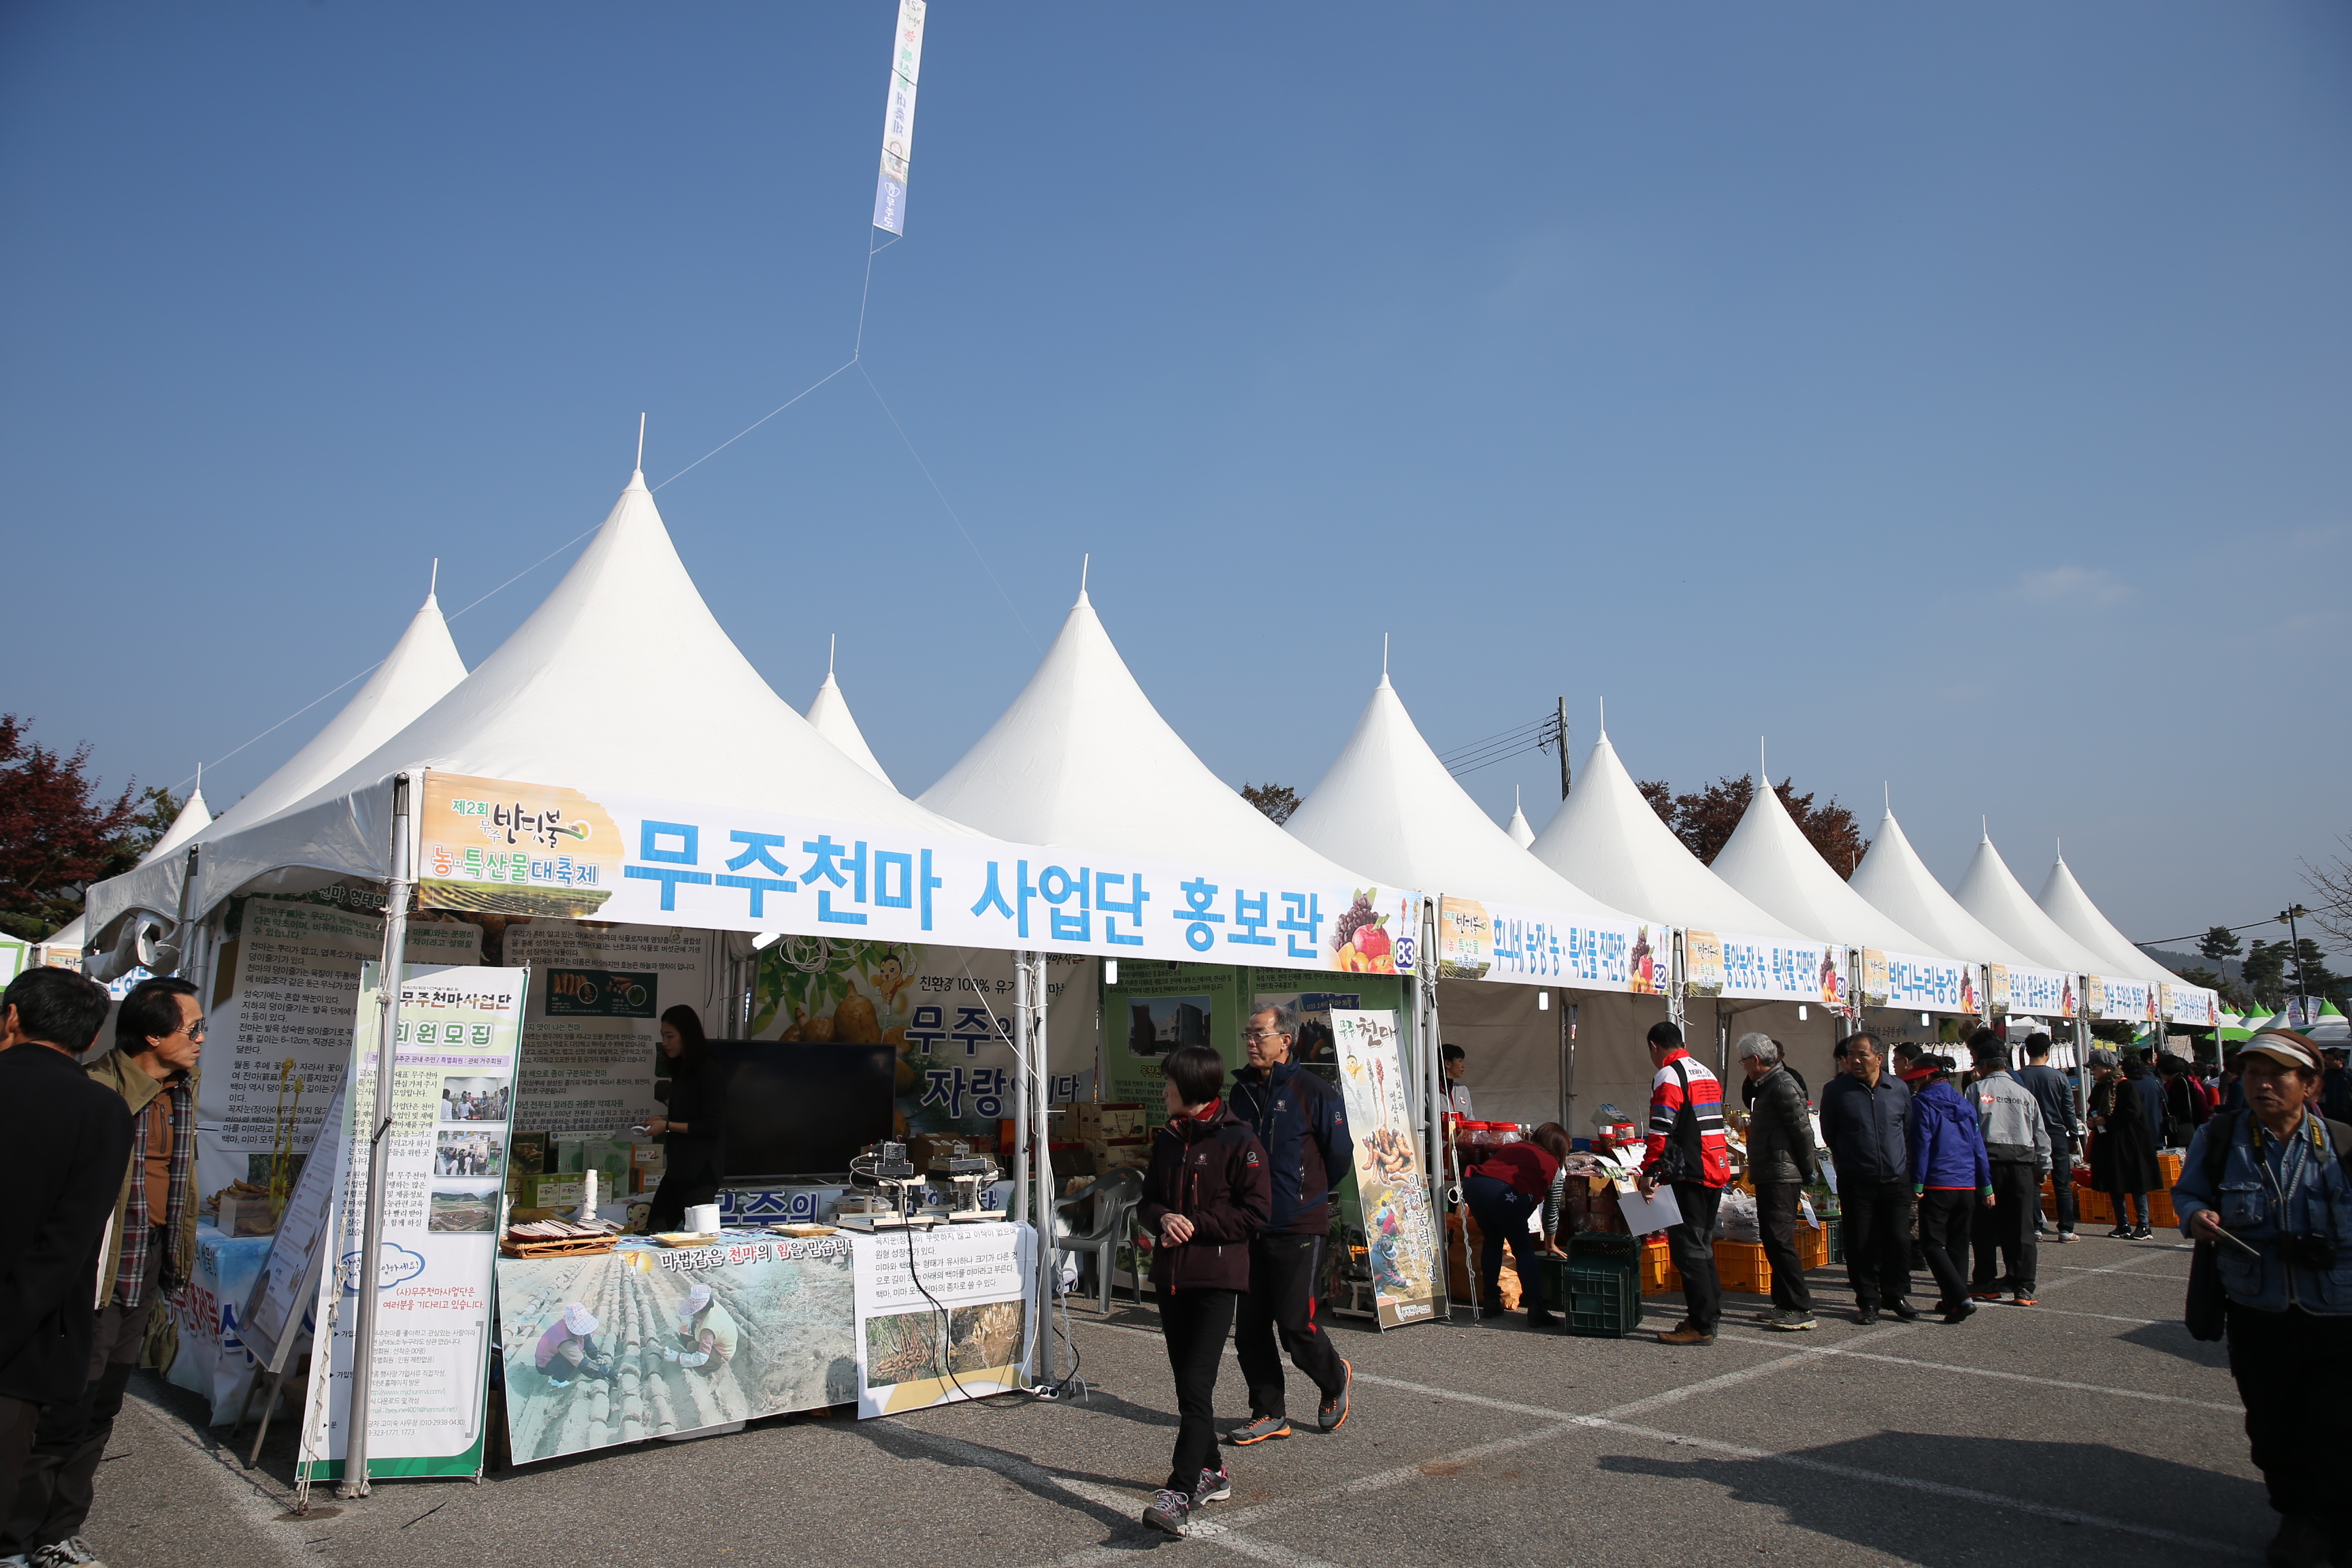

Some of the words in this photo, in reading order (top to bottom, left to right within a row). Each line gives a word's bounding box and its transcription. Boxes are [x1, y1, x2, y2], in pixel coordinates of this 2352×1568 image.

[452, 799, 489, 817] 제2회
[493, 802, 584, 849] 반딧불
[478, 819, 502, 843] 무주
[624, 819, 942, 931] 무주천마
[970, 860, 1150, 943] 사업단
[1173, 877, 1324, 959] 홍보관
[351, 889, 386, 908] 형태의
[310, 912, 336, 922] 우리가
[1443, 911, 1455, 919] 제2회
[1456, 913, 1488, 935] 반딧불
[255, 917, 271, 926] 다른
[313, 924, 353, 934] 비유하자면
[451, 929, 474, 938] 분명히
[250, 942, 274, 951] 천마는
[448, 940, 472, 948] 설명할
[1448, 938, 1479, 954] 농·특산물
[1493, 914, 1524, 973] 후니네
[1526, 921, 1546, 975] 농장
[1599, 931, 1626, 983] 직판장
[249, 953, 289, 964] 덩이줄기가
[291, 957, 306, 966] 있다.
[1396, 942, 1414, 965] 83
[1454, 953, 1478, 969] 대축제
[247, 964, 271, 973] 천마의
[273, 966, 309, 976] 덩이줄기는
[311, 968, 333, 978] 육질이
[1724, 943, 1757, 988] 통안농장
[1796, 951, 1817, 992] 직판장
[256, 975, 287, 985] 비늘조각
[919, 975, 953, 993] 친환경
[958, 978, 990, 992] 100%
[1654, 966, 1665, 986] 82
[1889, 961, 1957, 1004] 반디누리농장
[1838, 979, 1846, 996] 81
[2010, 973, 2026, 1007] 덕유산
[2028, 975, 2048, 1009] 젊은농부
[2051, 977, 2061, 1010] 농장
[244, 990, 282, 1000] 성숙기에는
[284, 993, 300, 1002] 혼합
[302, 994, 323, 1004] 싹눈이
[325, 996, 340, 1004] 있다.
[400, 992, 511, 1009] 무주천마사업단
[1974, 993, 1980, 1008] 80
[2104, 983, 2114, 1013] 옛날
[2117, 984, 2131, 1014] 추억의
[2132, 985, 2146, 1015] 뻥튀기
[242, 1001, 266, 1010] 지하의
[270, 1002, 309, 1013] 덩이줄기는
[313, 1006, 327, 1014] 발육
[331, 1007, 350, 1015] 단계에
[2072, 998, 2076, 1013] 79
[252, 1012, 267, 1021] 등이
[270, 1013, 287, 1022] 있다.
[239, 1023, 263, 1032] 전마는
[281, 1025, 305, 1034] 성숙한
[397, 1024, 491, 1045] 회원모집
[568, 1023, 581, 1031] 천마
[1338, 1020, 1356, 1040] 무주
[1356, 1017, 1399, 1047] 천마
[238, 1034, 254, 1043] 보통
[256, 1035, 279, 1043] 길이는
[313, 1038, 336, 1047] 직경은
[236, 1045, 261, 1054] 달한다.
[234, 1060, 250, 1069] 월동
[254, 1062, 270, 1070] 후에
[300, 1062, 323, 1072] 자라서
[566, 1069, 592, 1077] 구분되는
[595, 1069, 607, 1077] 천마
[229, 1094, 246, 1102] 이다.
[1395, 1079, 1405, 1112] 최고의
[531, 1100, 551, 1109] 전부터
[1389, 1091, 1399, 1124] 명산지
[2313, 1126, 2321, 1145] Nikon
[926, 1233, 953, 1241] 뚜렷하지
[957, 1232, 971, 1240] 않고
[974, 1230, 994, 1239] 이삭이
[996, 1228, 1019, 1237] 없으며,
[662, 1247, 727, 1271] 마법같은
[728, 1245, 771, 1264] 천마의
[776, 1242, 803, 1260] 힘을
[808, 1239, 855, 1257] 믿습니
[875, 1250, 889, 1259] 원형
[921, 1247, 936, 1256] 있다.
[876, 1262, 897, 1271] 미마와
[923, 1258, 944, 1268] 형태가
[946, 1256, 973, 1266] 유사하나
[975, 1254, 994, 1263] 크기가
[997, 1252, 1009, 1260] 다른
[1011, 1251, 1017, 1260] 것
[876, 1277, 890, 1285] 으로
[892, 1275, 905, 1284] 길이
[923, 1271, 943, 1280] 아래의
[945, 1269, 965, 1279] 백마를
[966, 1267, 992, 1277] 미마라고
[994, 1264, 1014, 1273] 부른다.
[397, 1286, 475, 1298] (사)무주천마사업단은
[877, 1289, 892, 1298] 백마,
[894, 1288, 907, 1297] 미마
[924, 1284, 945, 1294] 천마의
[947, 1281, 966, 1292] 종자로
[968, 1281, 974, 1289] 쓸
[976, 1279, 983, 1288] 수
[984, 1278, 997, 1288] 있다.
[382, 1300, 414, 1309] 여러분을
[417, 1300, 448, 1309] 기다리고
[451, 1299, 485, 1309] 있습니다.
